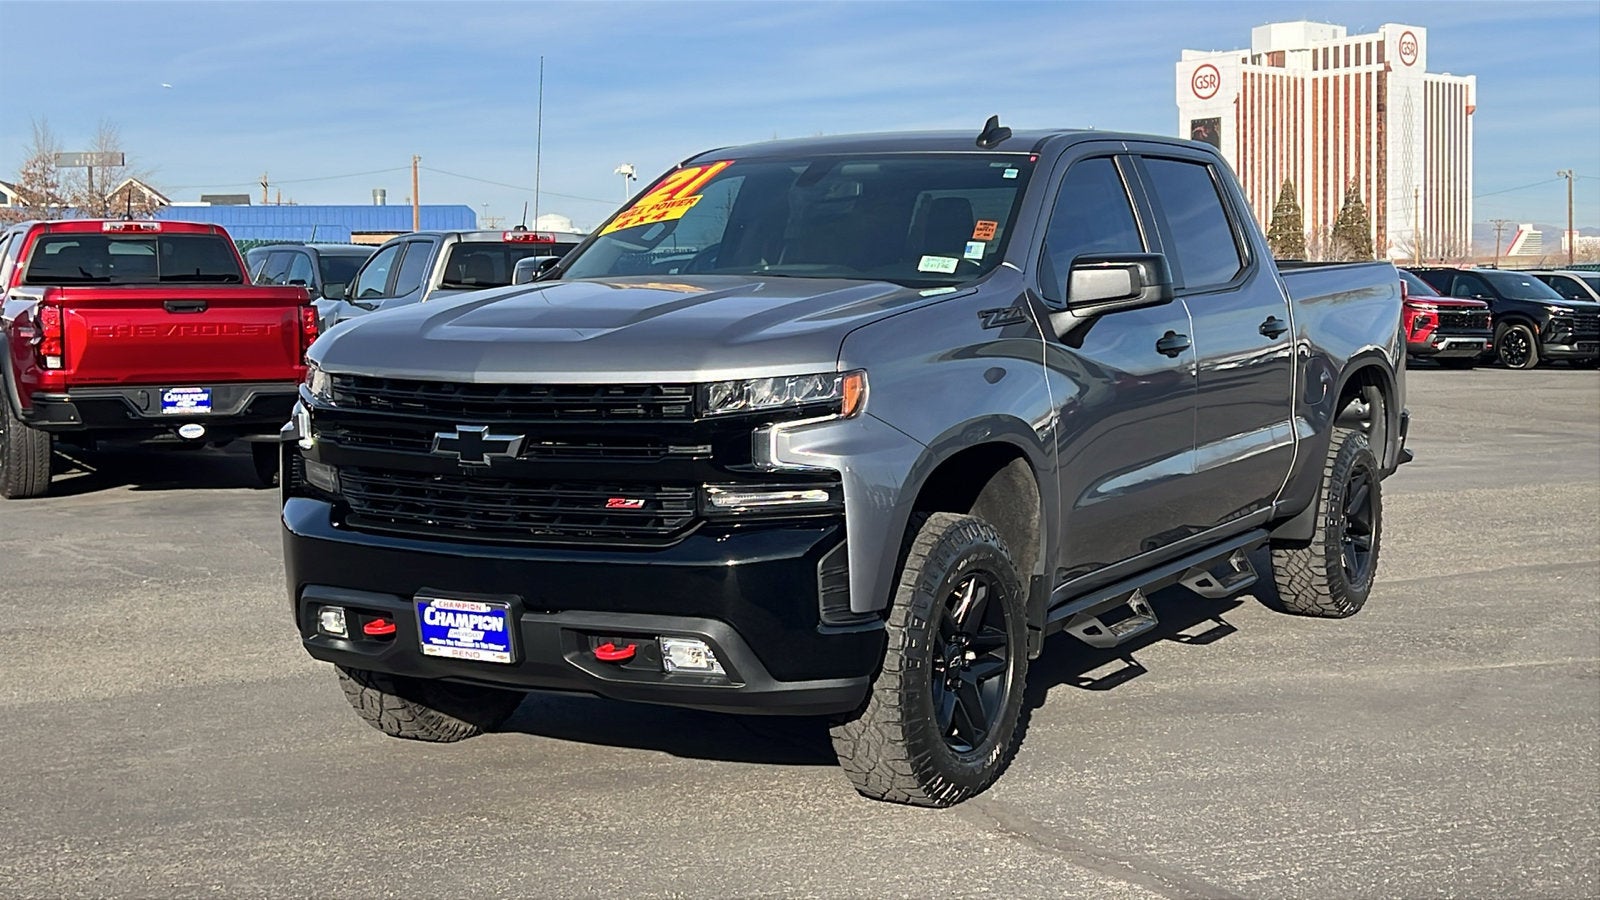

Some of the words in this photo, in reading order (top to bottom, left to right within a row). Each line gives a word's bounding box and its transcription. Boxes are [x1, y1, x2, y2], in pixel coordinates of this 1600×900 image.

[1402, 41, 1416, 56] GSR
[1195, 74, 1216, 89] GSR
[647, 197, 698, 212] POWER
[91, 323, 278, 338] CHEVROLET
[605, 498, 646, 509] Z71
[438, 600, 482, 611] CHAMPION
[424, 606, 504, 632] CHAMPION
[452, 649, 481, 659] RENO
